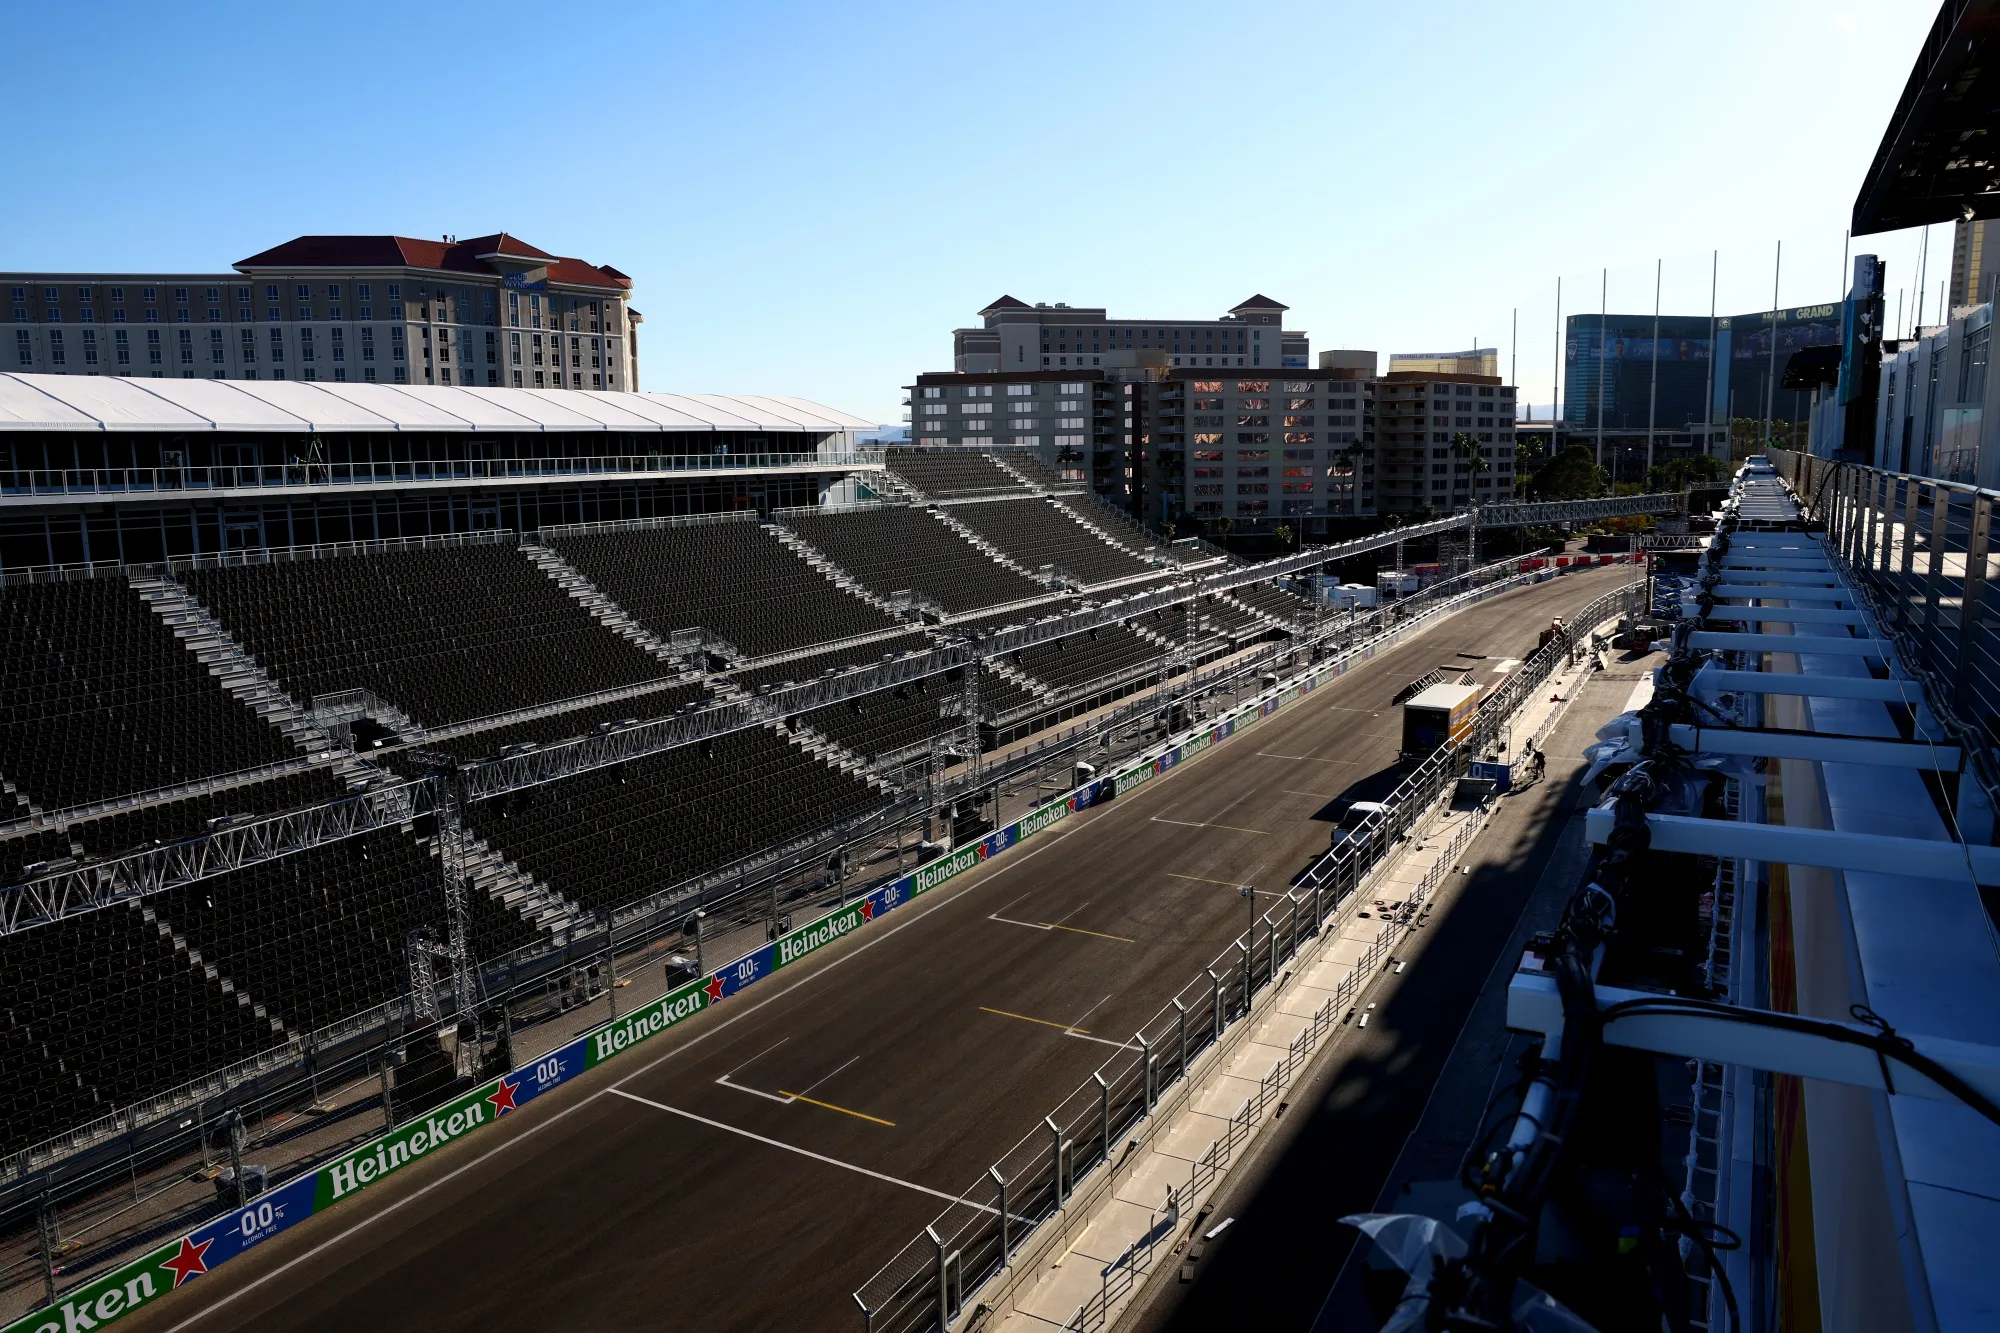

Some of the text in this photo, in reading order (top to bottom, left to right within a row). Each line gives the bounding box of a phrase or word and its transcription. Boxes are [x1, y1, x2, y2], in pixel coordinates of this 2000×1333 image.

[507, 272, 527, 280] CLUB
[1796, 304, 1833, 319] GRAND
[1181, 735, 1211, 761] Heineken
[1115, 764, 1153, 796] Heineken
[1019, 803, 1066, 839] Heineken
[916, 850, 975, 894] Heineken
[780, 910, 858, 965] Heineken
[595, 991, 702, 1061] Heineken
[328, 1103, 485, 1199] Heineken
[242, 1223, 278, 1247] ALCOHOL FREE
